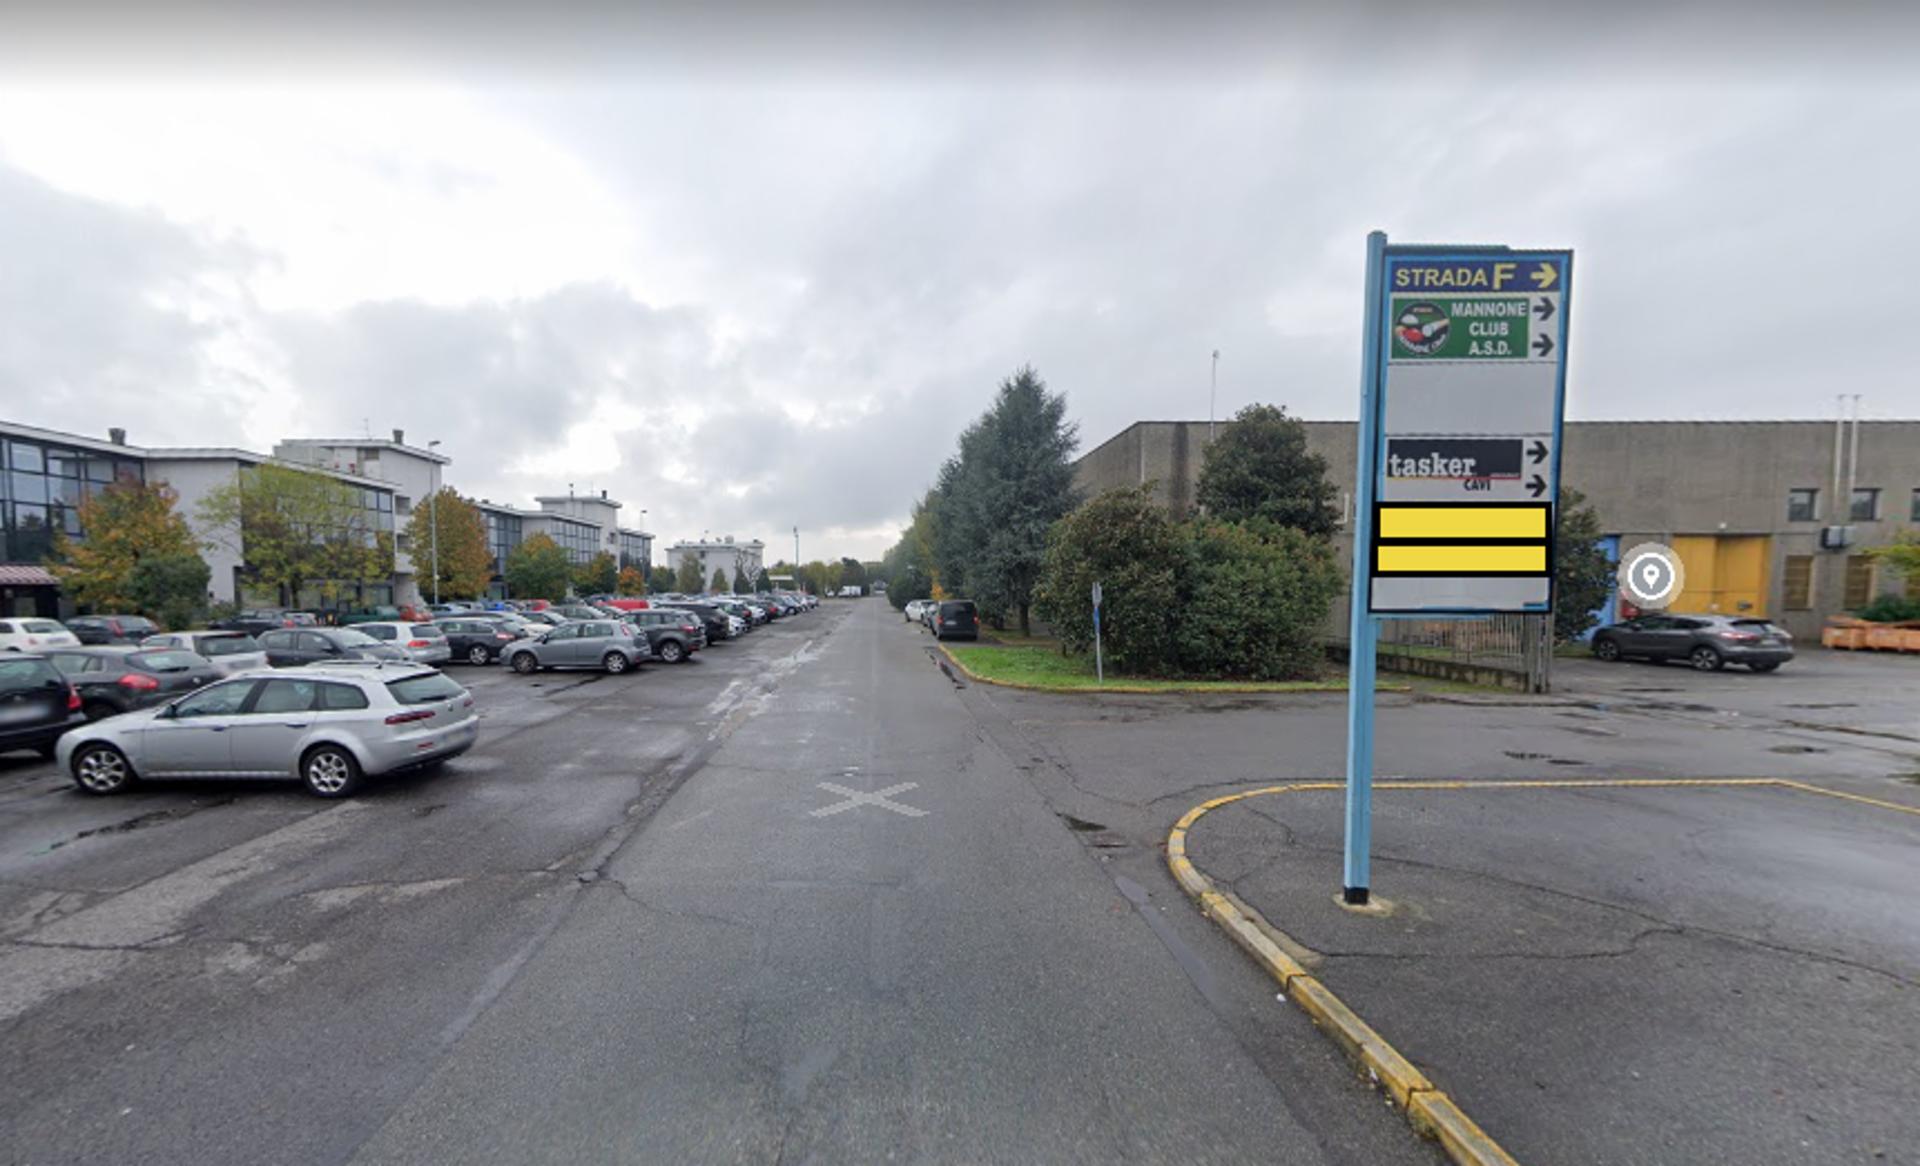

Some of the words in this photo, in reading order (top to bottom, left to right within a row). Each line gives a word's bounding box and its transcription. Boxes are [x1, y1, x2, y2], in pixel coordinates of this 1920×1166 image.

[1395, 268, 1488, 287] STRADA
[1493, 263, 1517, 290] F
[1451, 302, 1527, 317] MANNONE
[1468, 322, 1509, 336] CLUB
[1468, 341, 1511, 355] A.S.D.
[1389, 452, 1476, 477] tasker
[1463, 479, 1491, 491] CAVI
